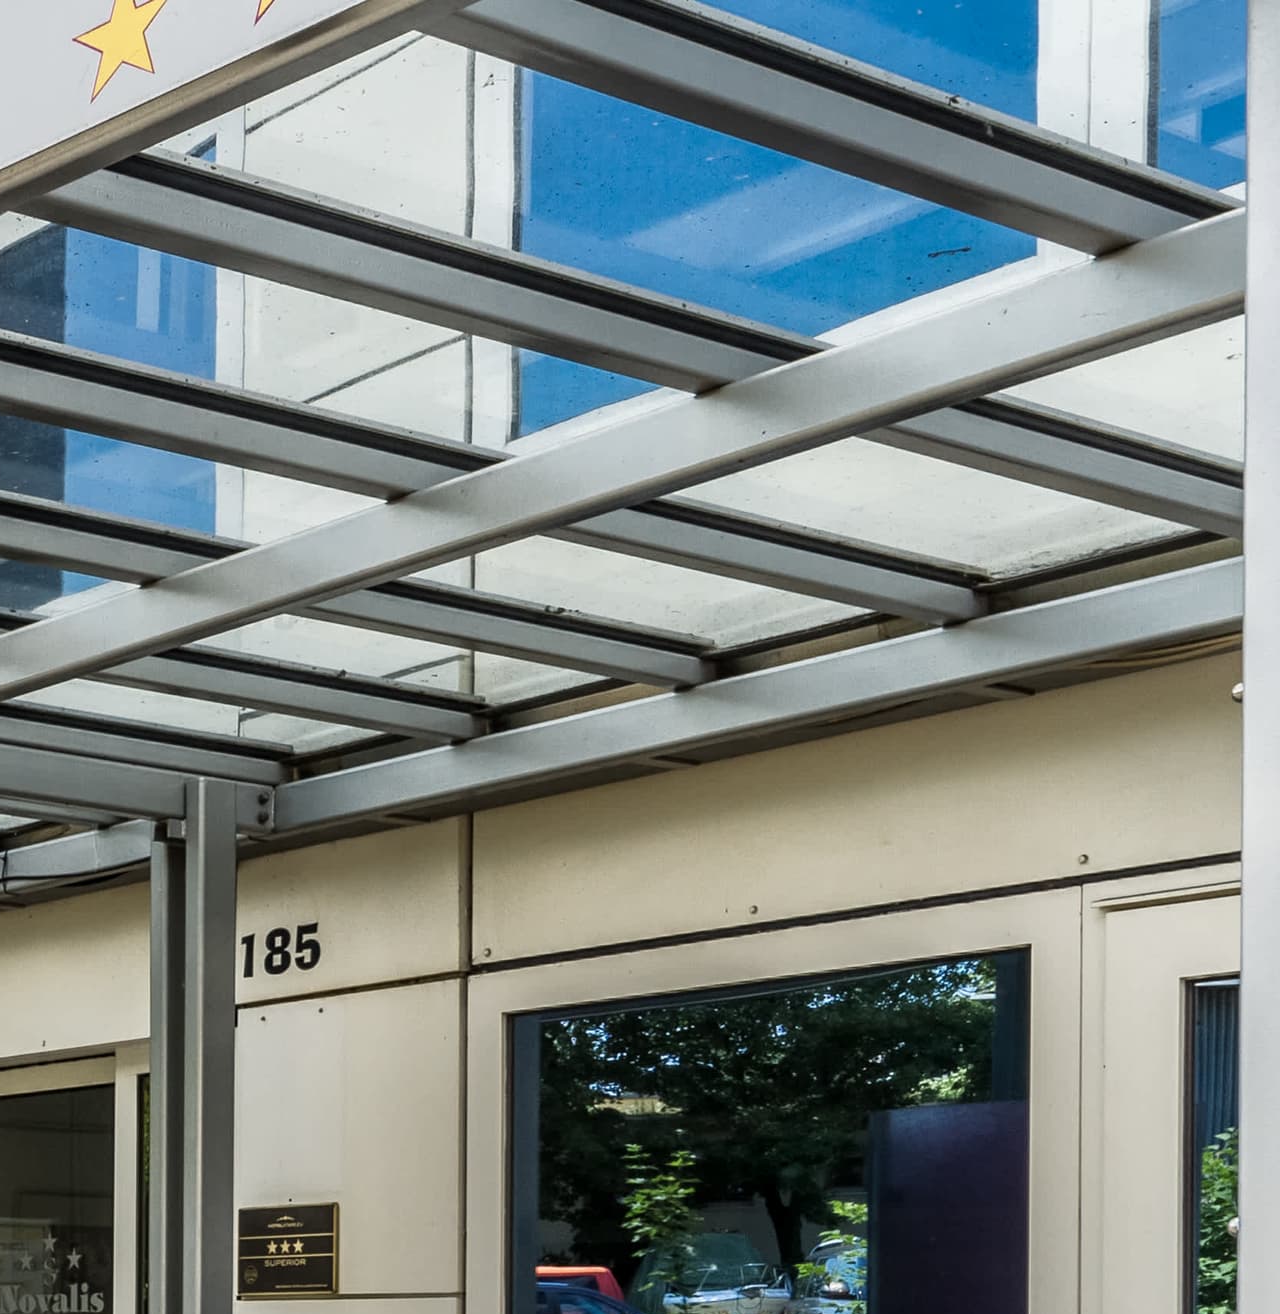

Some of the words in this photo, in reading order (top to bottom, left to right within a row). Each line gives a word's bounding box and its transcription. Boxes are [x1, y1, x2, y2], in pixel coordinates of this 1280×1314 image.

[241, 922, 321, 978] 185
[264, 1258, 307, 1267] SUPERIOR
[0, 1283, 104, 1314] Novalis
